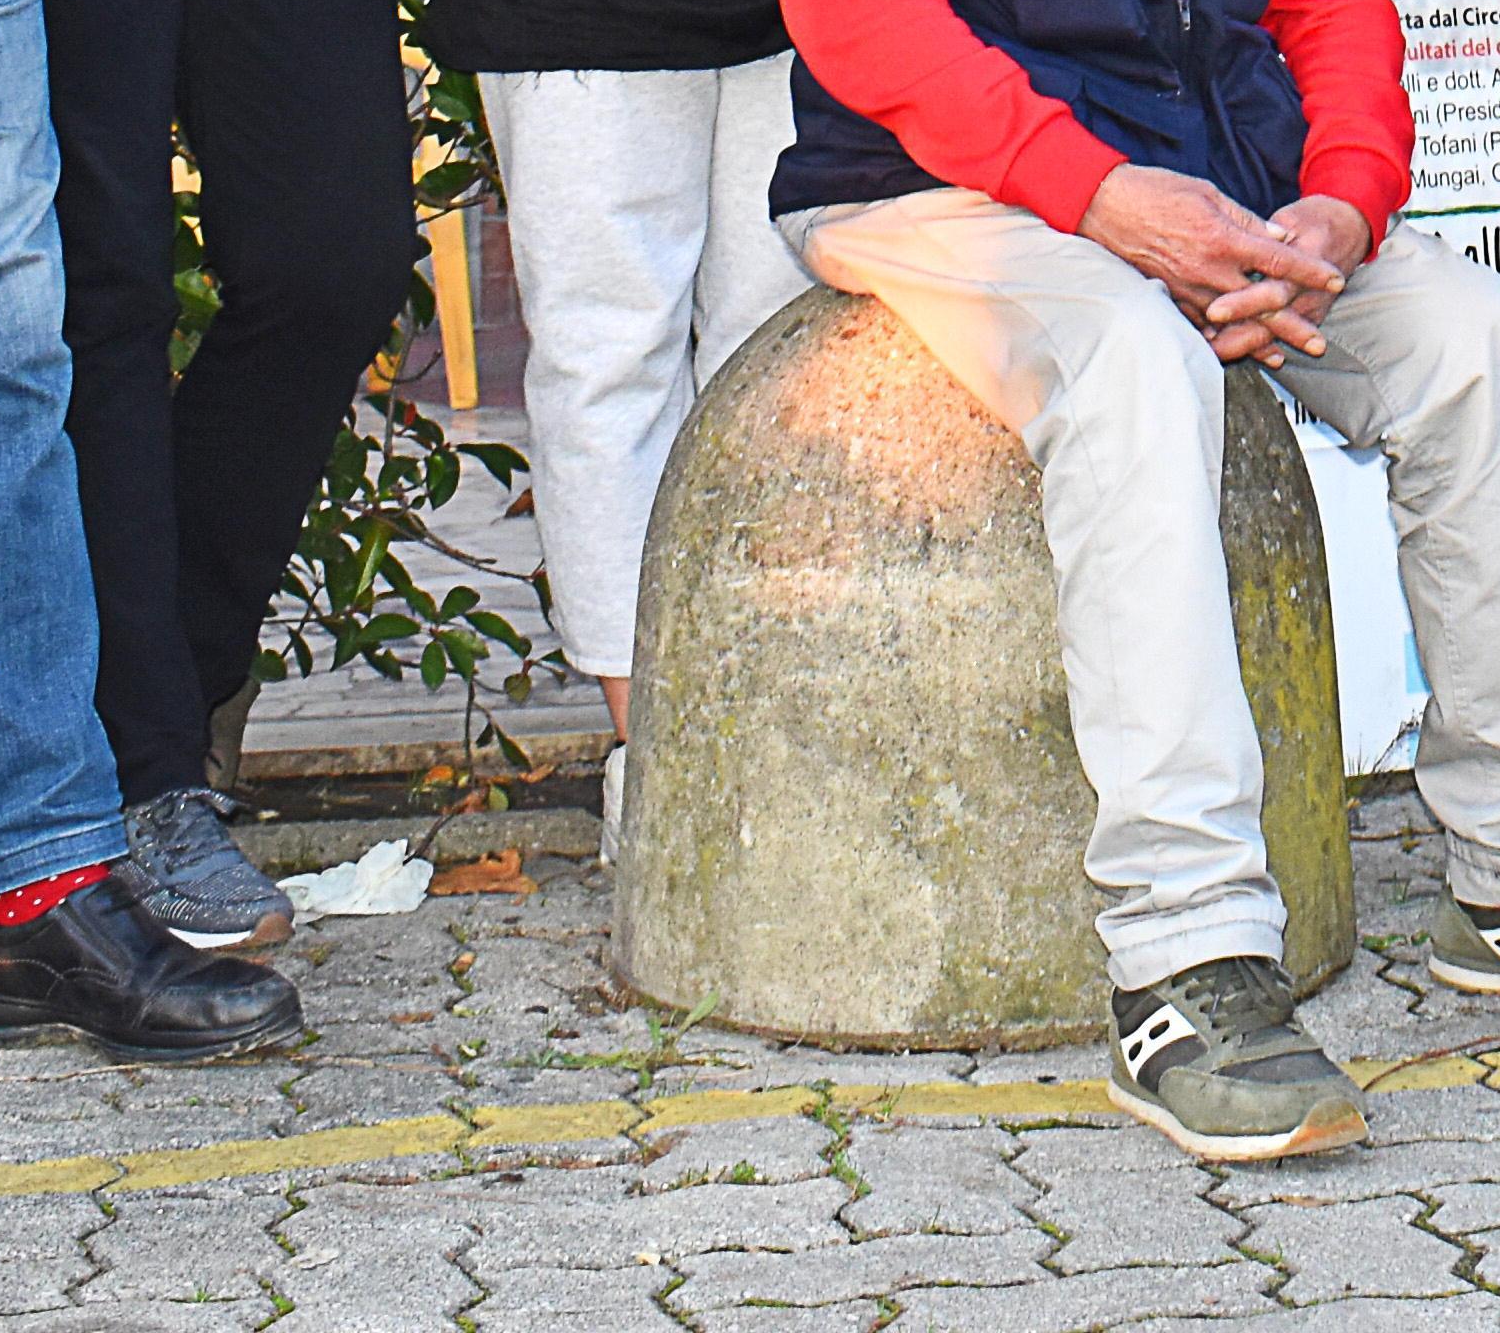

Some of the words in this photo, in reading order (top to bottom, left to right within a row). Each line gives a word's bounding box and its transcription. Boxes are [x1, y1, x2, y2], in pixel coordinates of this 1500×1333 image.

[1429, 7, 1458, 29] dal
[1462, 36, 1492, 58] del
[1427, 75, 1439, 93] e
[1444, 70, 1486, 92] dott.
[1419, 132, 1478, 157] Tofani
[1409, 164, 1486, 192] Mungai,
